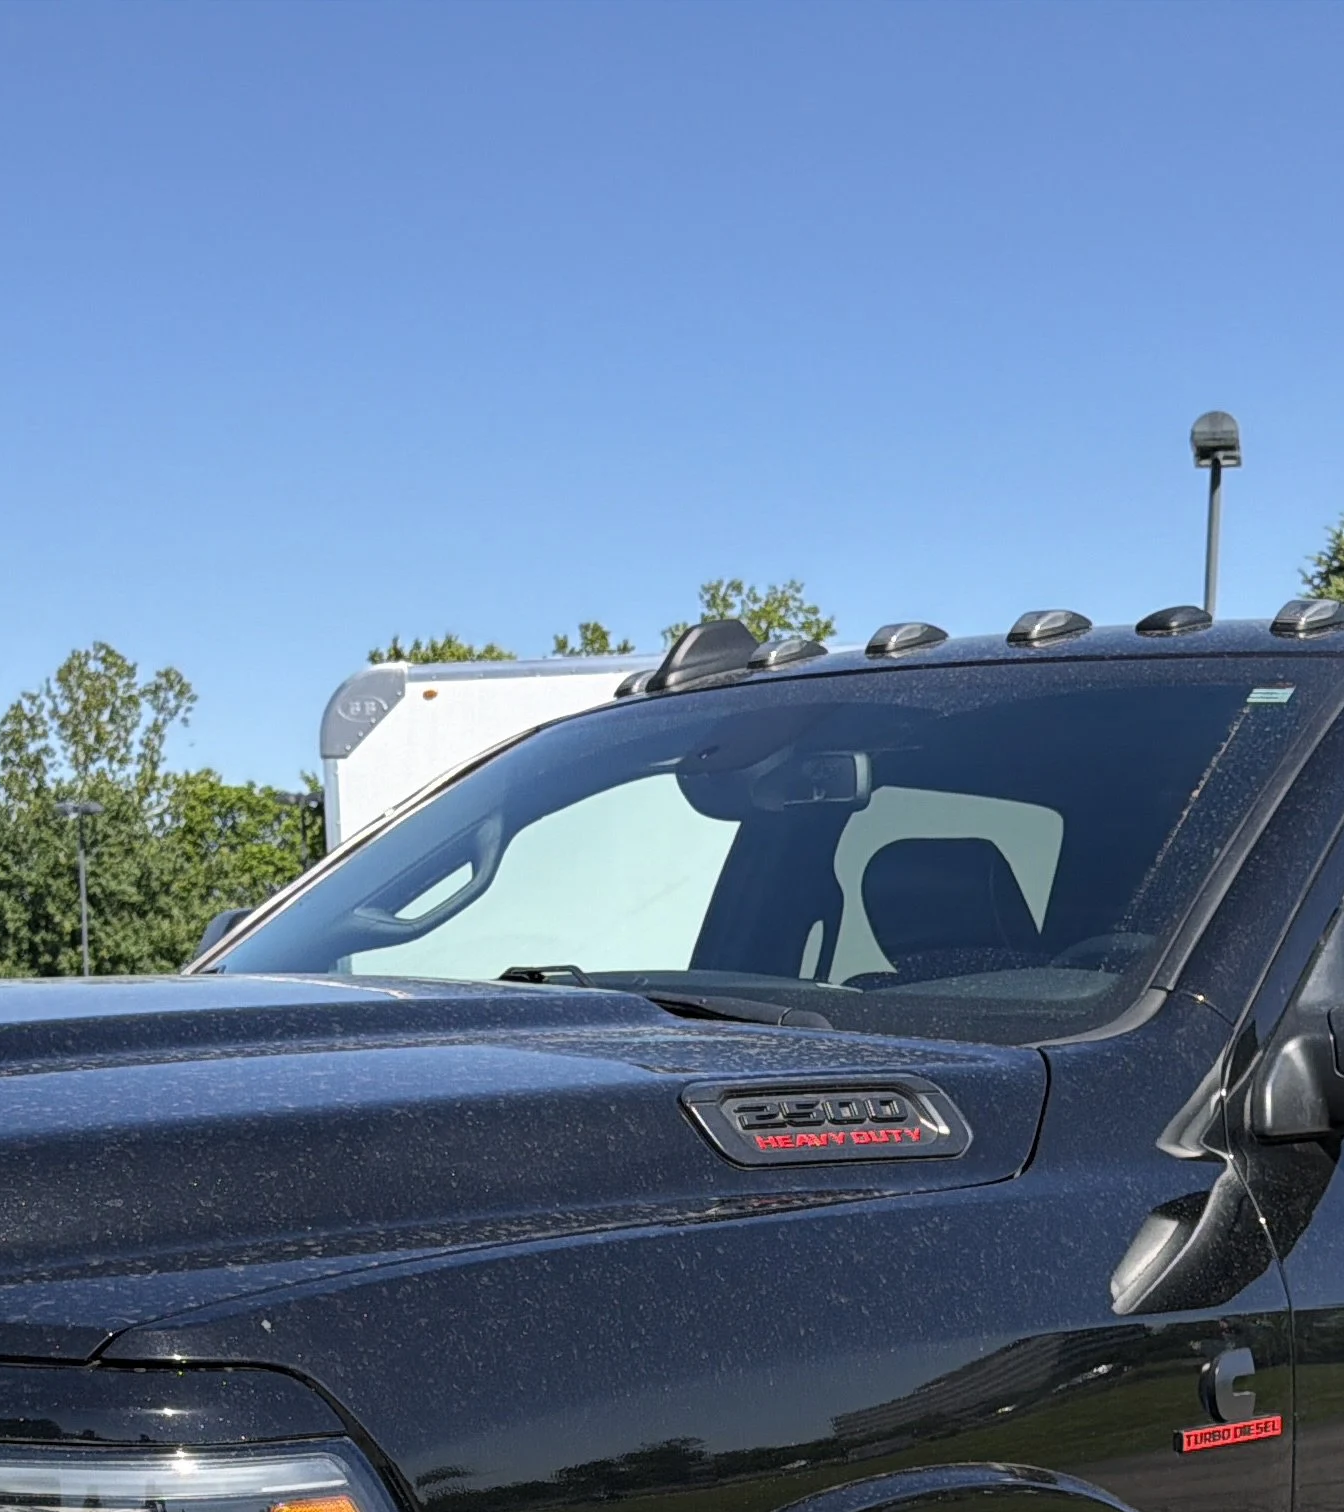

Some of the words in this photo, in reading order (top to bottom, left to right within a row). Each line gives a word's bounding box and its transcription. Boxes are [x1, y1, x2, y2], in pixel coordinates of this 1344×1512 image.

[734, 1098, 908, 1130] 2500
[756, 1130, 845, 1150] HEAVY
[849, 1127, 922, 1146] DUTY
[1184, 1427, 1232, 1448] TURBO
[1233, 1418, 1280, 1439] DIESEL
